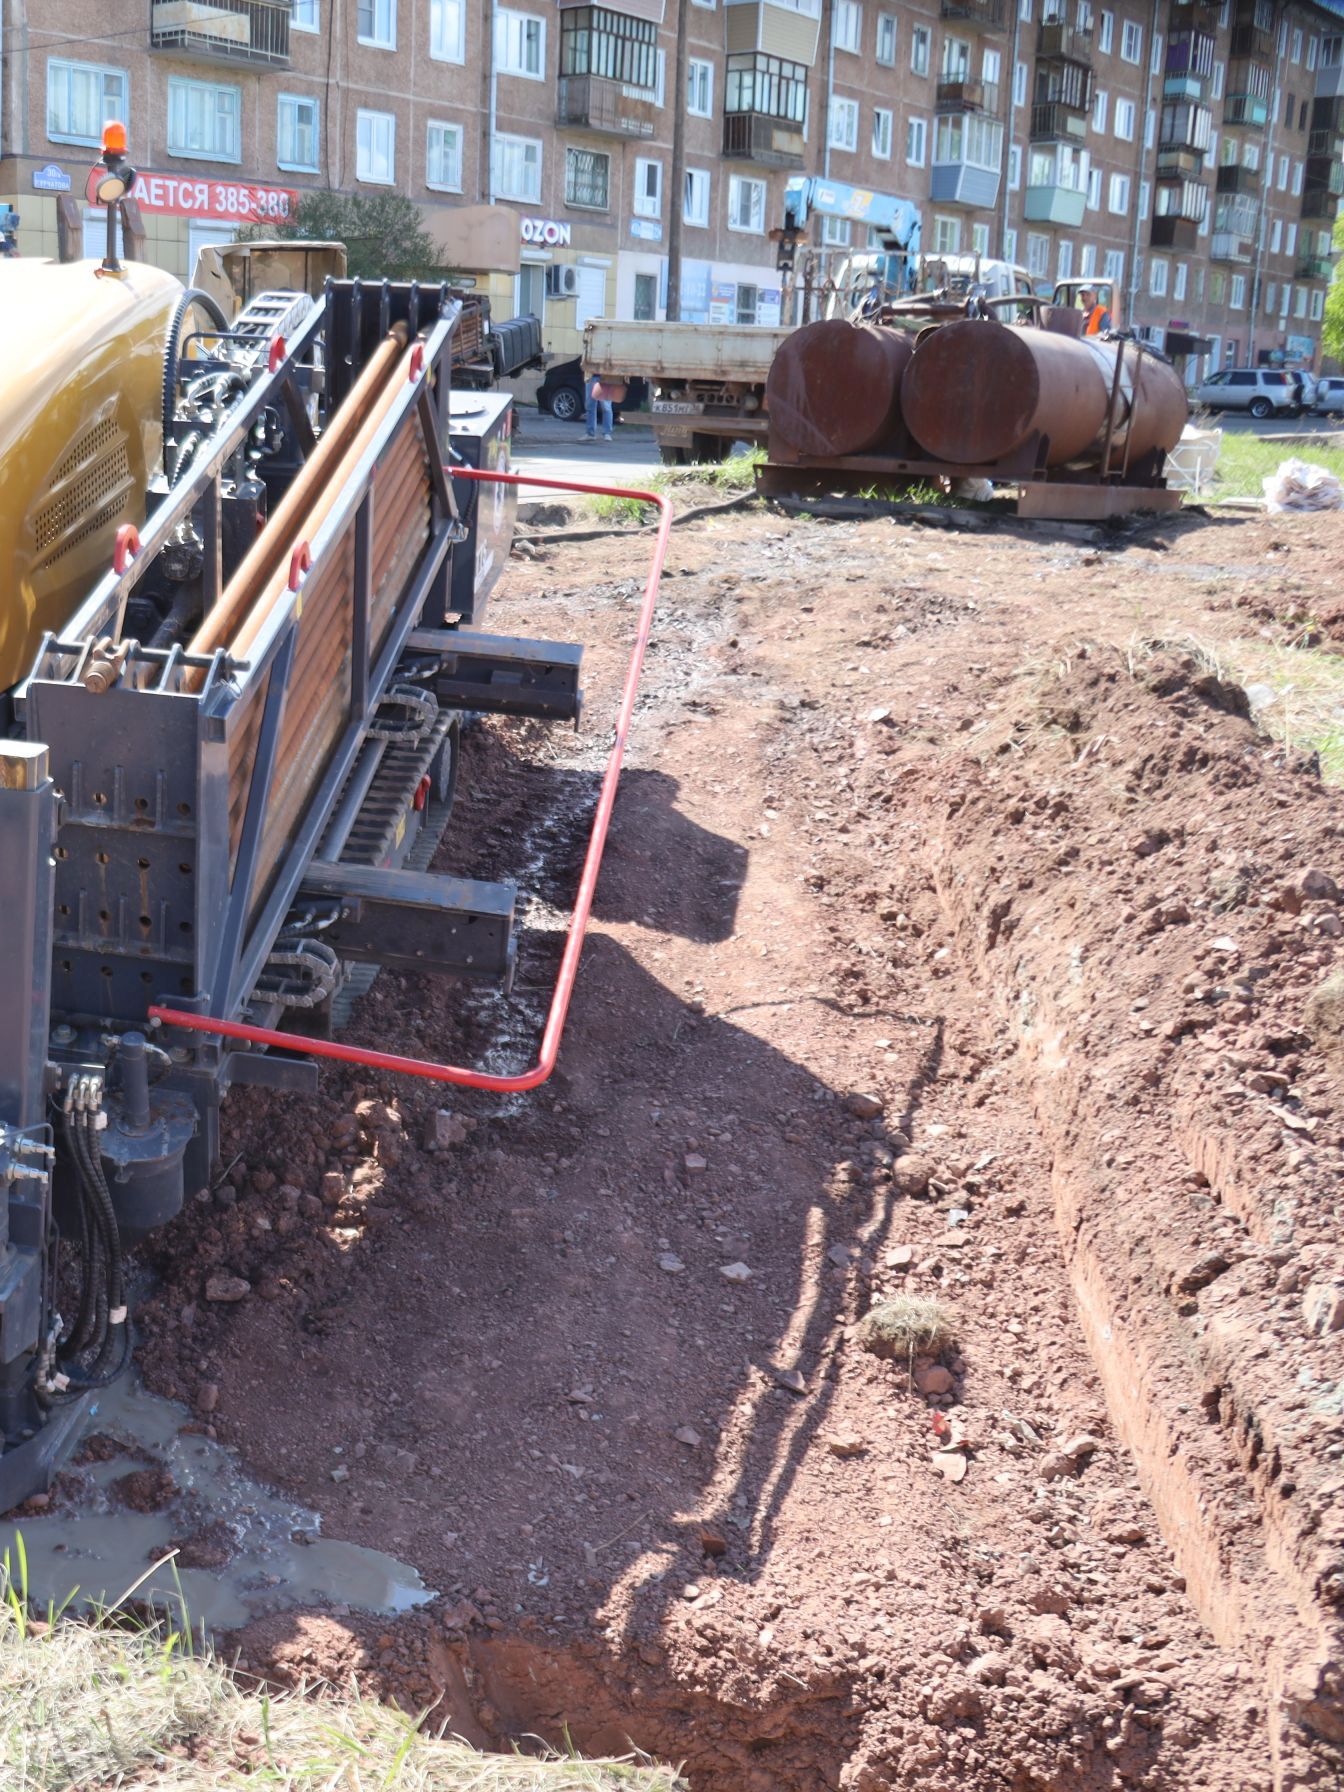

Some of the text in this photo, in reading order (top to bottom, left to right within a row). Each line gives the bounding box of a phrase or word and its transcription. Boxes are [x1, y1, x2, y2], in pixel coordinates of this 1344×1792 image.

[127, 175, 290, 218] АЕТСЯ 385-380
[521, 217, 571, 245] OZON
